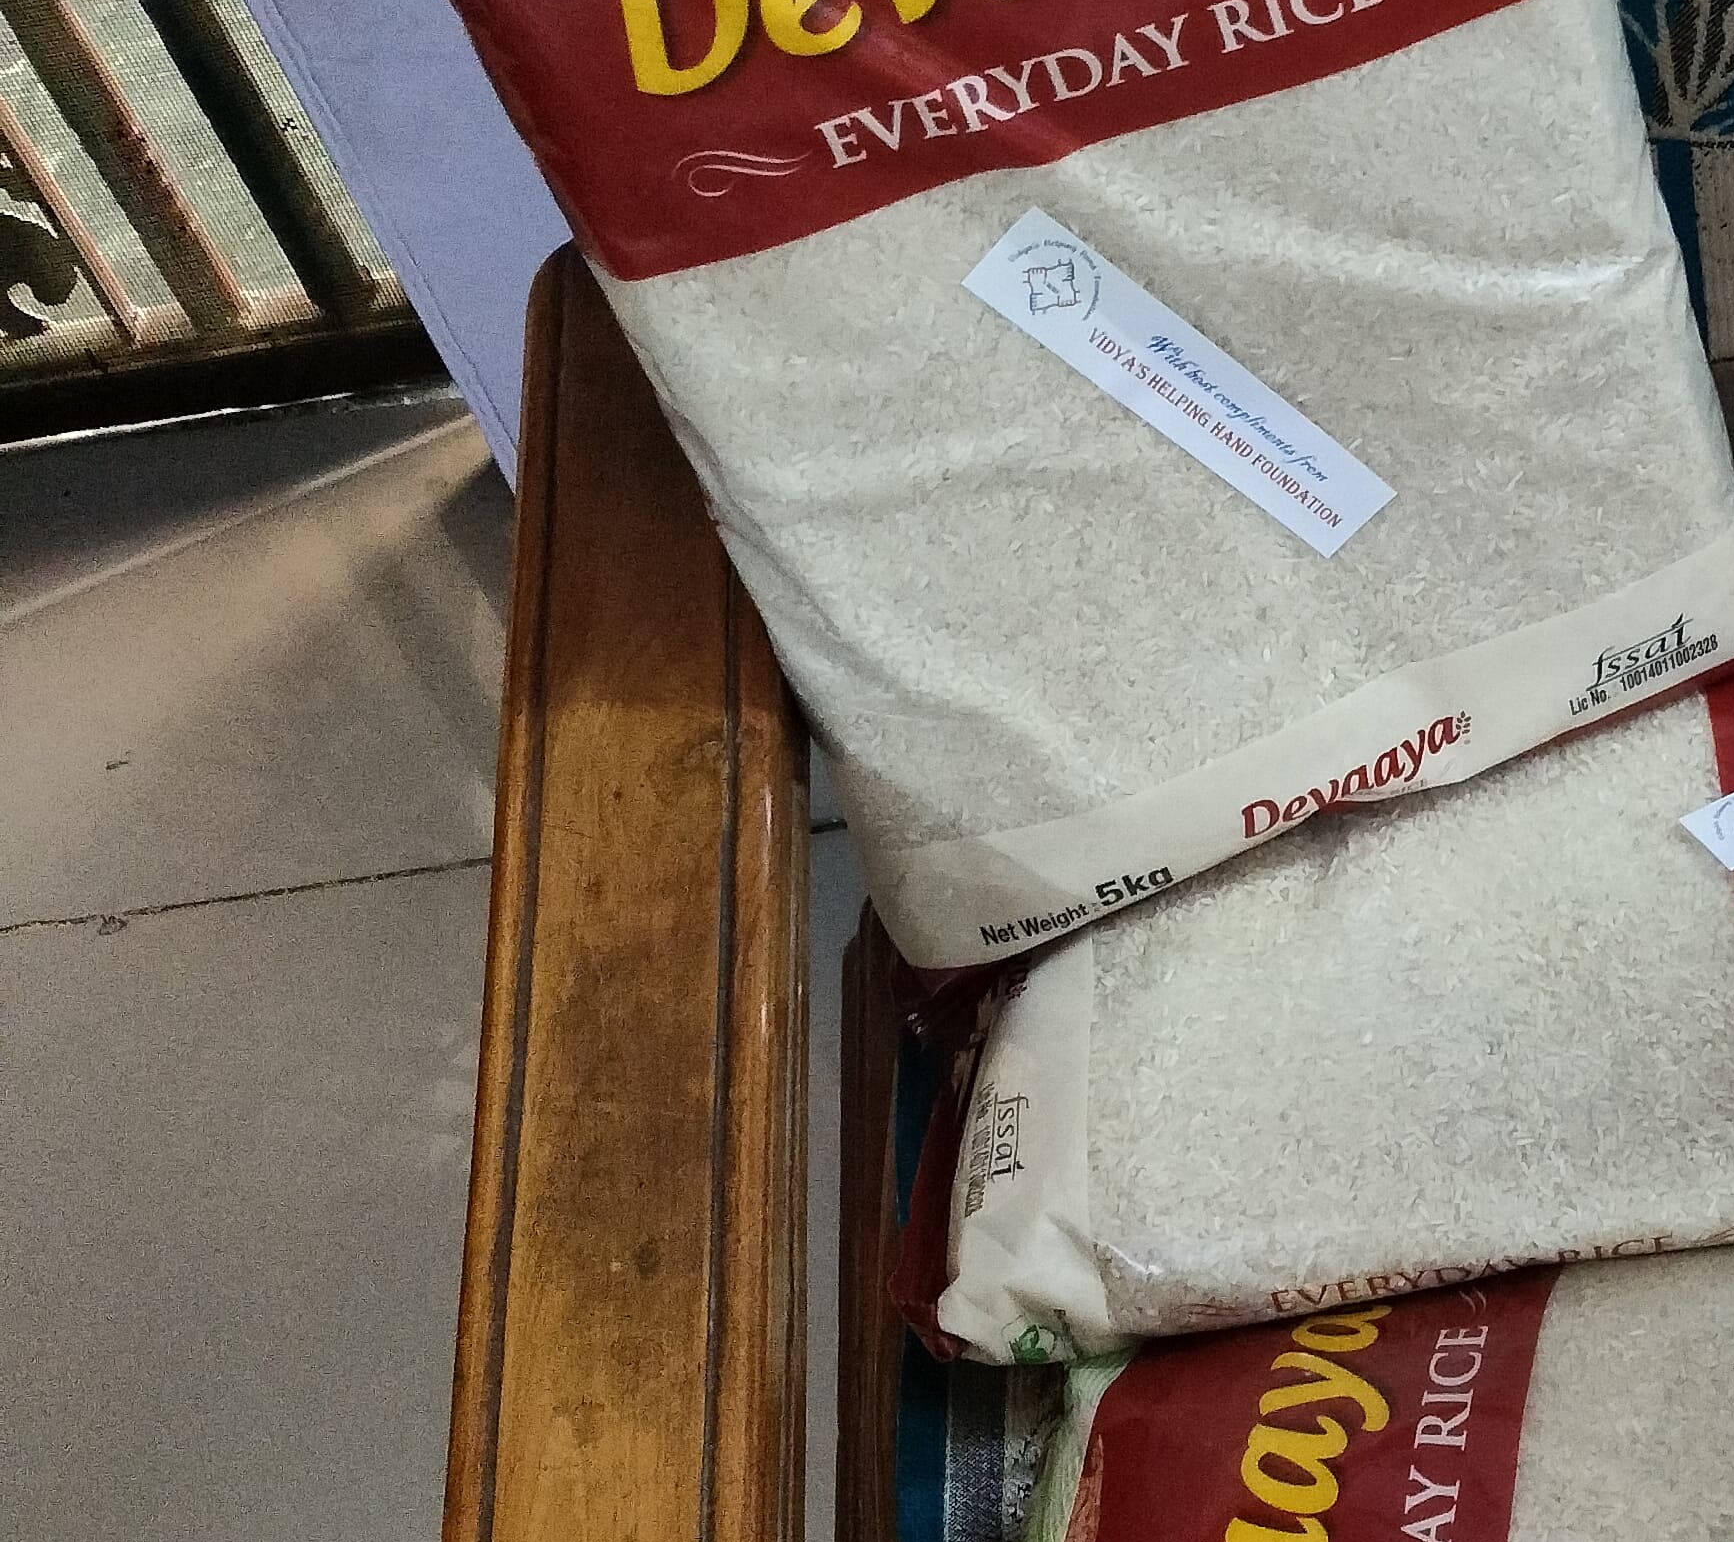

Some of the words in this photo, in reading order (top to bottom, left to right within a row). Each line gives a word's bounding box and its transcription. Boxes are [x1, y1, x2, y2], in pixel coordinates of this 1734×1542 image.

[815, 12, 1190, 169] EVERYDAY
[1087, 328, 1150, 381] VIDYA'S
[1147, 377, 1208, 429] HELPING
[1210, 421, 1253, 461] HAND
[1252, 454, 1343, 530] FOUNDATION
[1148, 334, 1196, 377] With
[1216, 391, 1296, 459] compliments
[1291, 454, 1329, 484] from
[1569, 698, 1588, 715] Lic
[1620, 634, 1718, 691] 10014011002328
[1589, 612, 1693, 686] fssai
[1242, 716, 1461, 838] Devaaya
[980, 922, 1019, 946] Net
[1018, 903, 1089, 936] Weight
[1415, 1325, 1488, 1450] RICE
